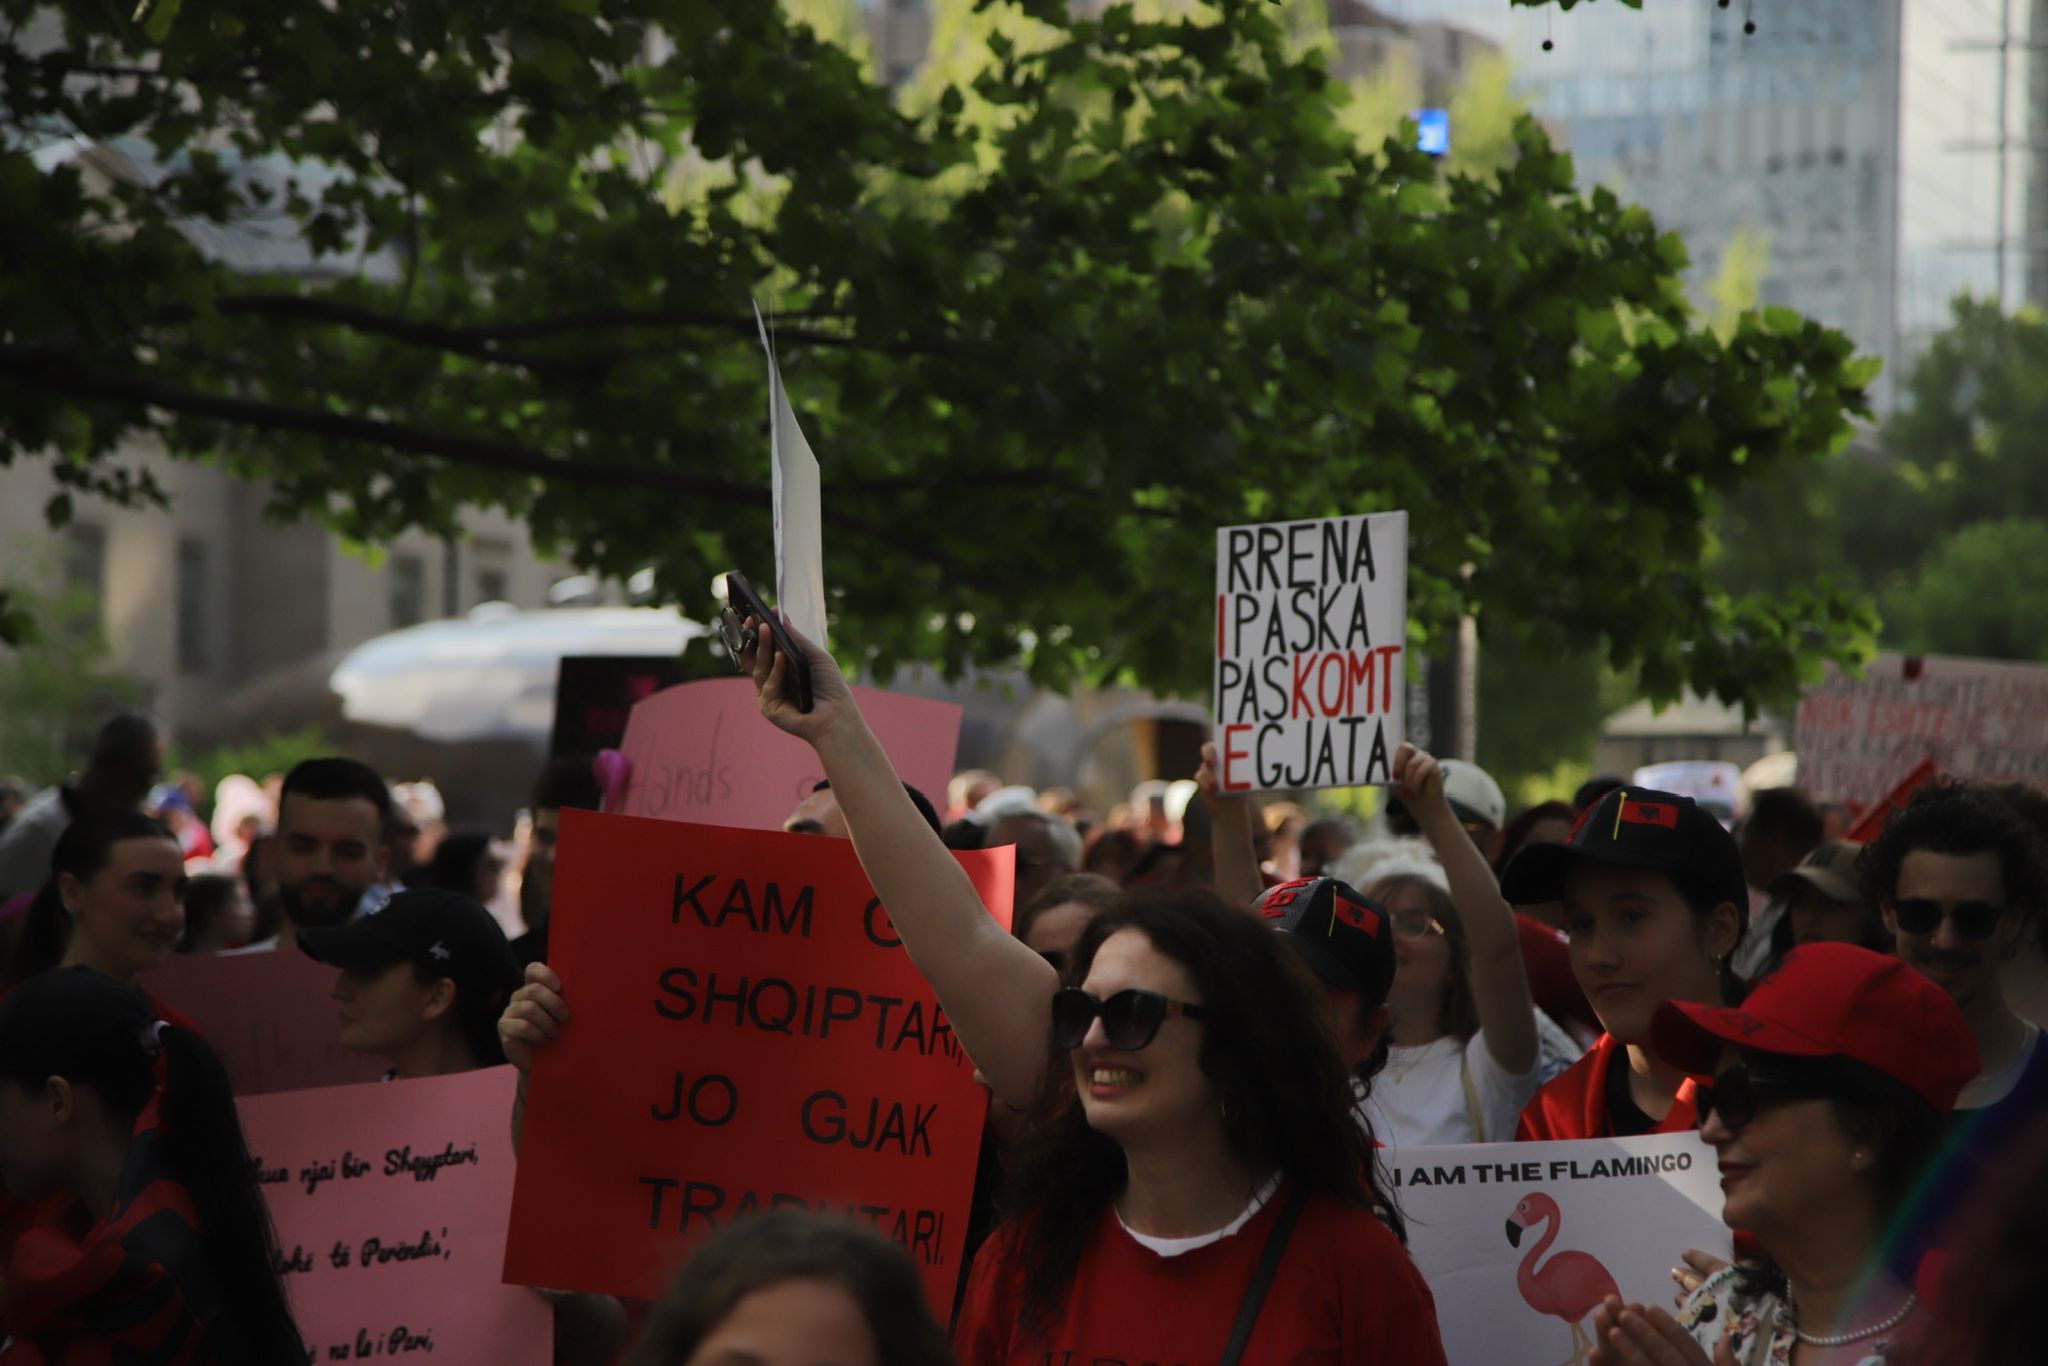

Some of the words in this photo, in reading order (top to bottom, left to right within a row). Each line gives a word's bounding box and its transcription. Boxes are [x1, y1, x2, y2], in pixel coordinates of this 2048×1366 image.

[1229, 519, 1375, 593] RRENA
[1235, 583, 1370, 658] PASKA
[670, 872, 816, 938] KAM
[651, 1071, 739, 1128] JO
[801, 1089, 938, 1158] GJAK
[342, 1151, 372, 1180] bir
[1393, 1167, 1402, 1188] I
[1408, 1165, 1467, 1187] AM
[1472, 1162, 1544, 1184] THE
[1550, 1152, 1693, 1181] FLAMINGO
